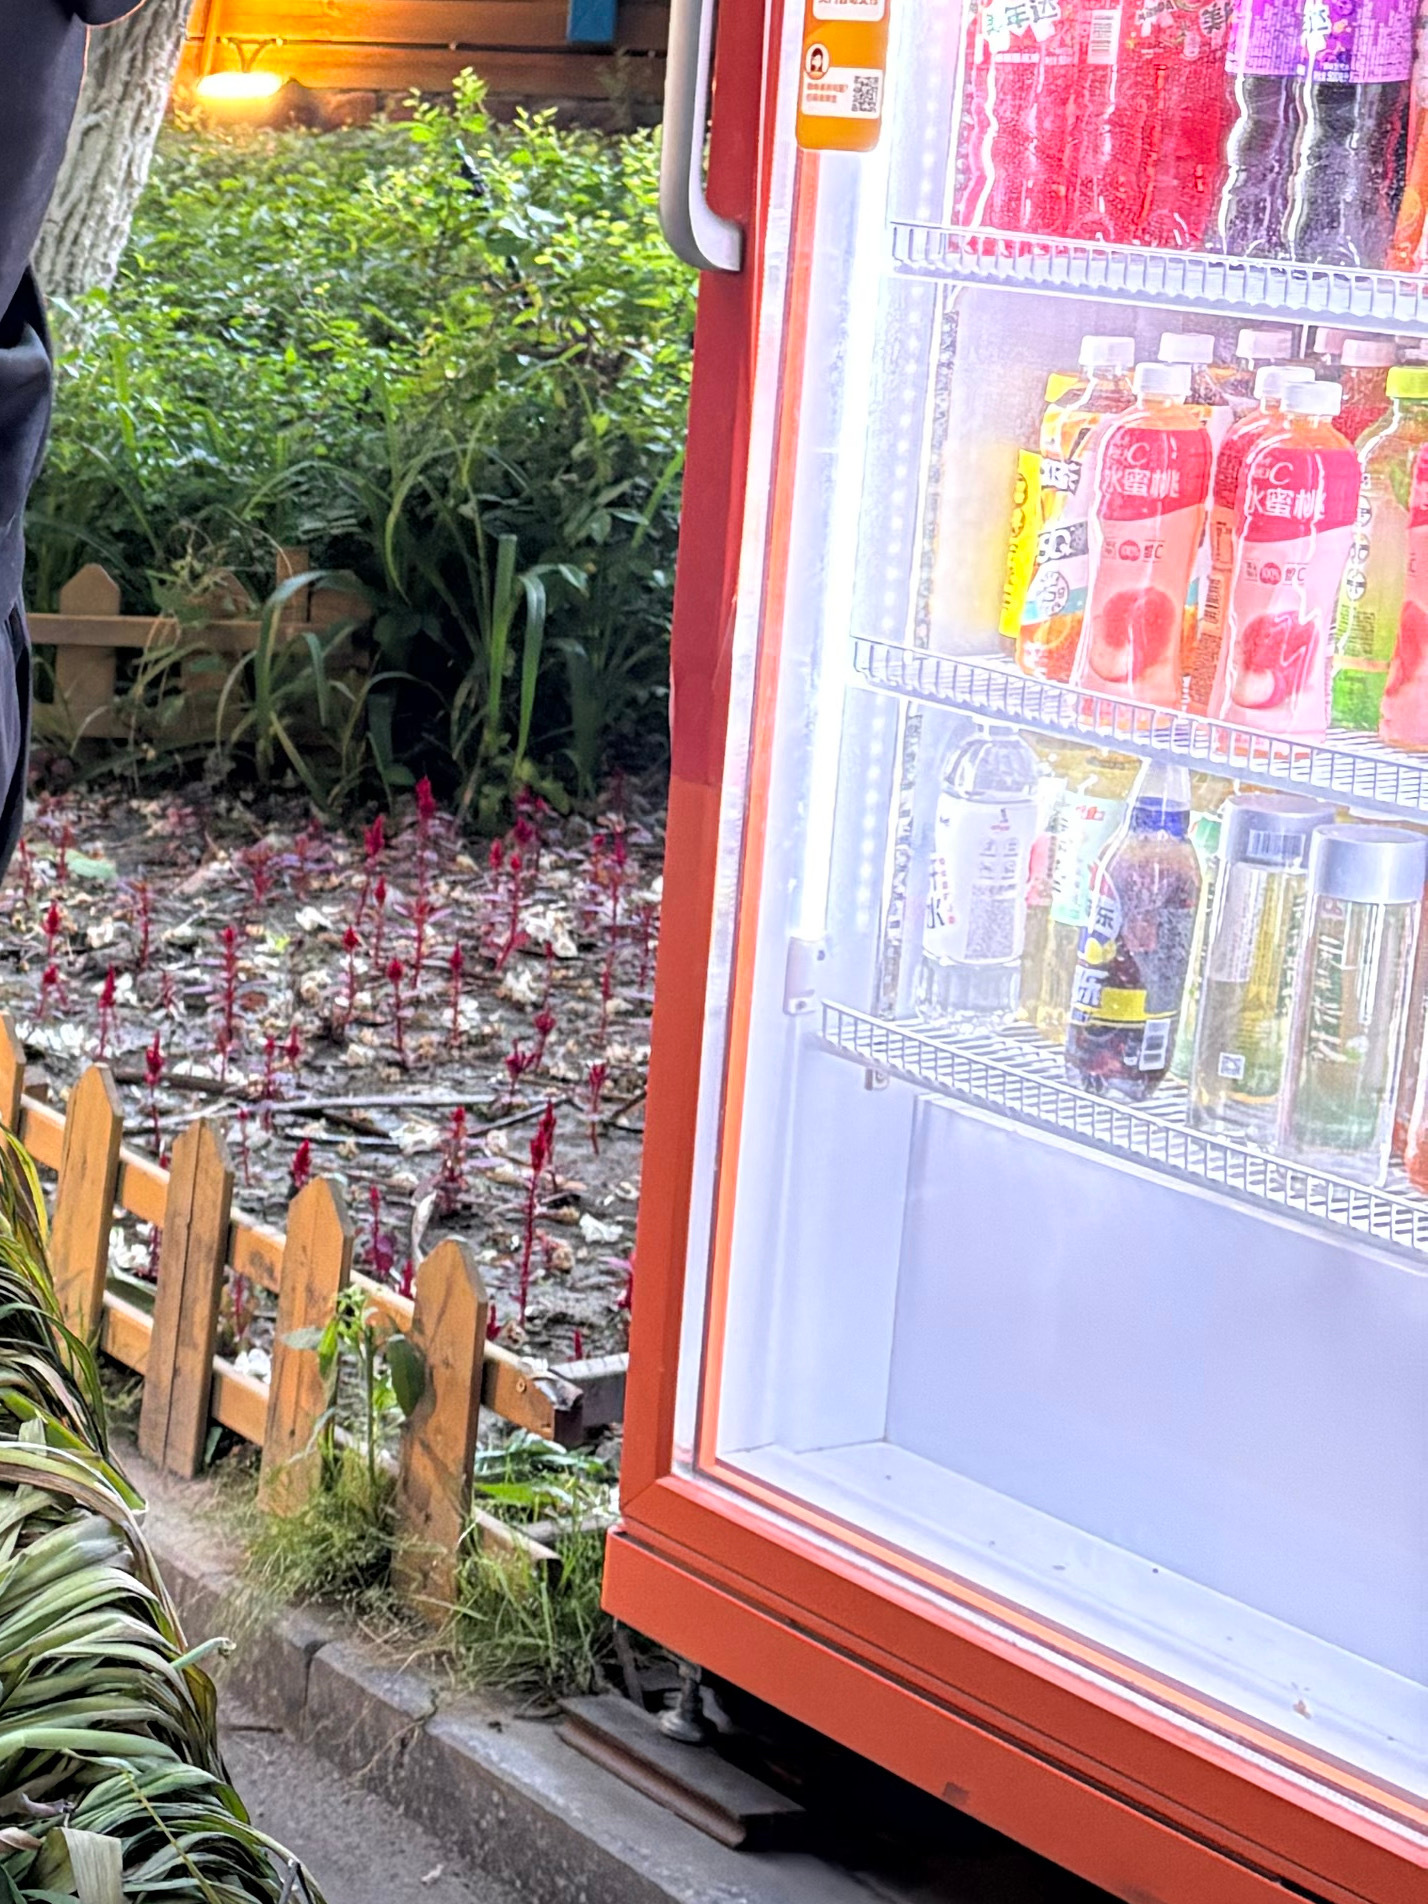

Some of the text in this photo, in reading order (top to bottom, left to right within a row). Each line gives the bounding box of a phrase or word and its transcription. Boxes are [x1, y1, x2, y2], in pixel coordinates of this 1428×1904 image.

[1104, 466, 1180, 498] 水蜜桃
[1248, 486, 1326, 520] 水蜜桃
